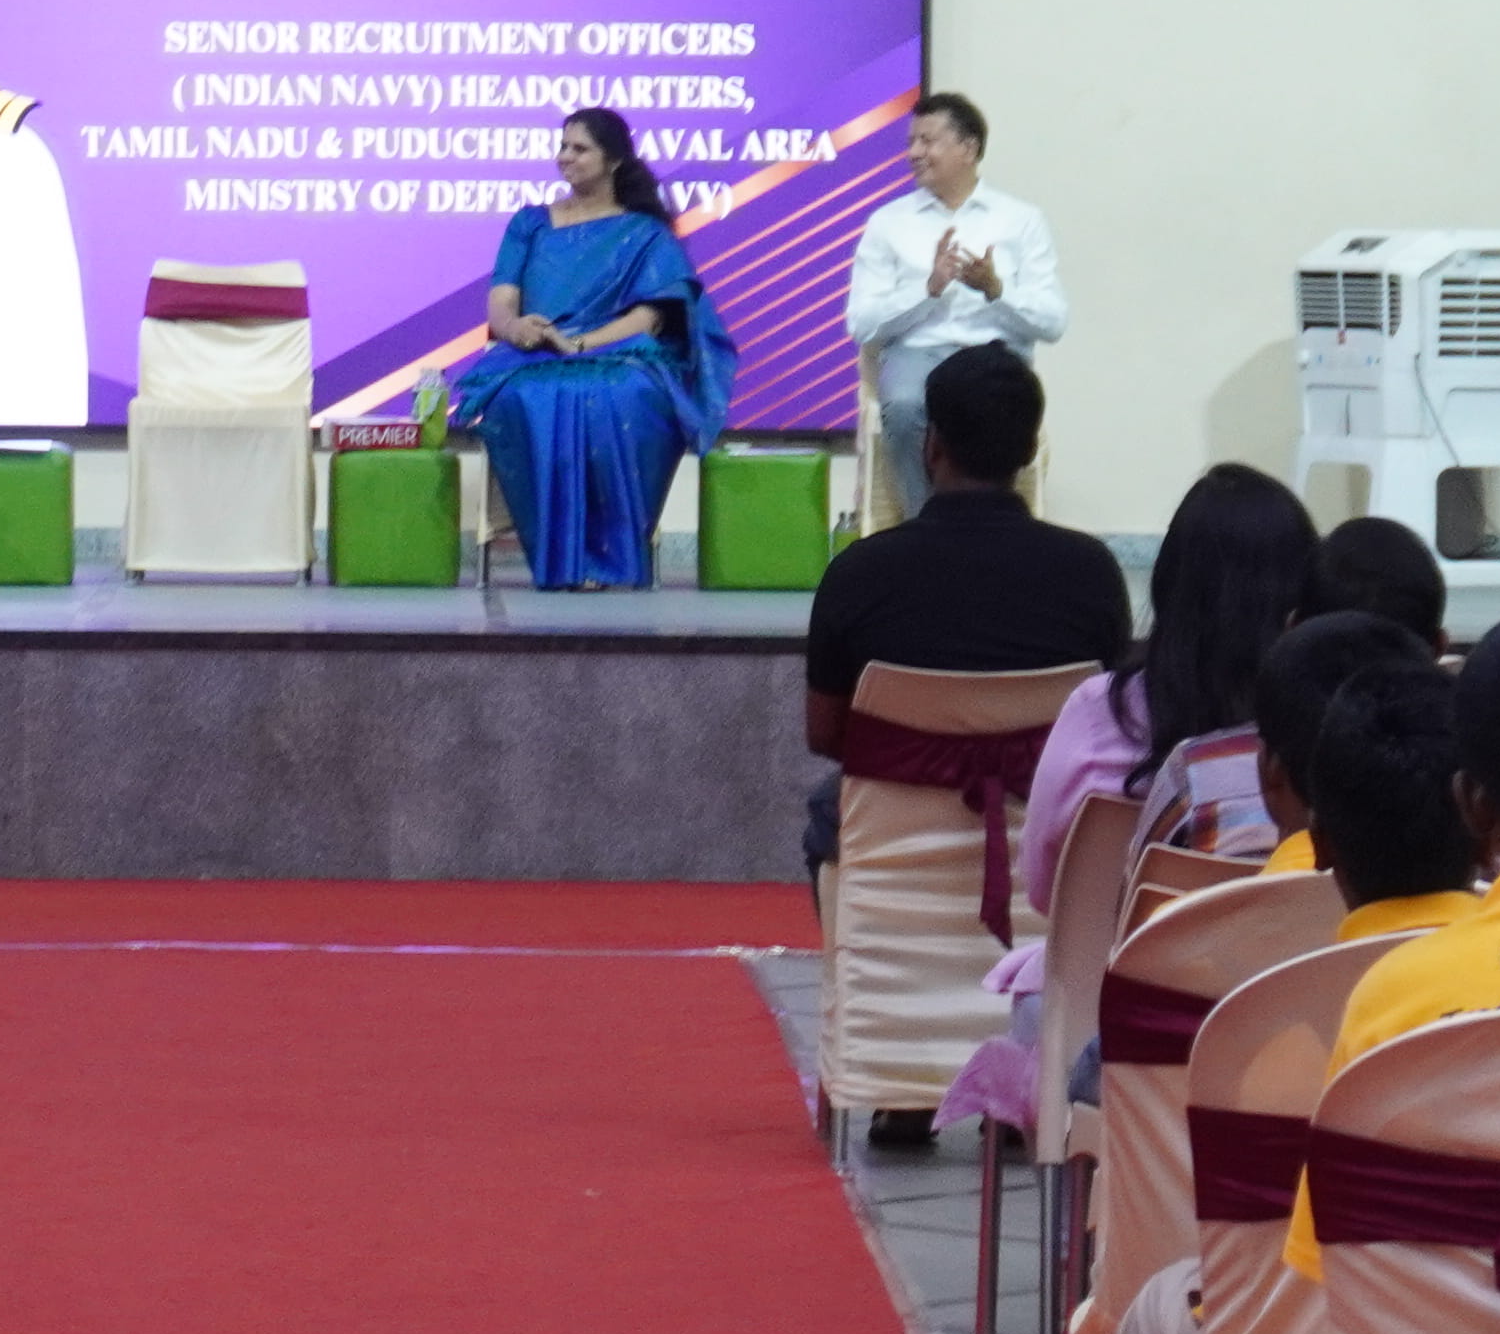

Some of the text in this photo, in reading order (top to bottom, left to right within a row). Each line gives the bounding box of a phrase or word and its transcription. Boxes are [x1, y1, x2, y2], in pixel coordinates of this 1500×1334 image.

[163, 20, 756, 57] SENIOR RECRUITMENT OFFICERS
[330, 73, 443, 115] NAVY)
[448, 74, 756, 115] HEADQUARTERS,
[80, 125, 838, 162] TAMIL NADU & PUDUCHER AVAL AREA
[184, 178, 363, 213] MINISTRY
[368, 178, 421, 213] OF
[426, 178, 573, 214] DEFENC
[337, 426, 418, 446] PREMIER
